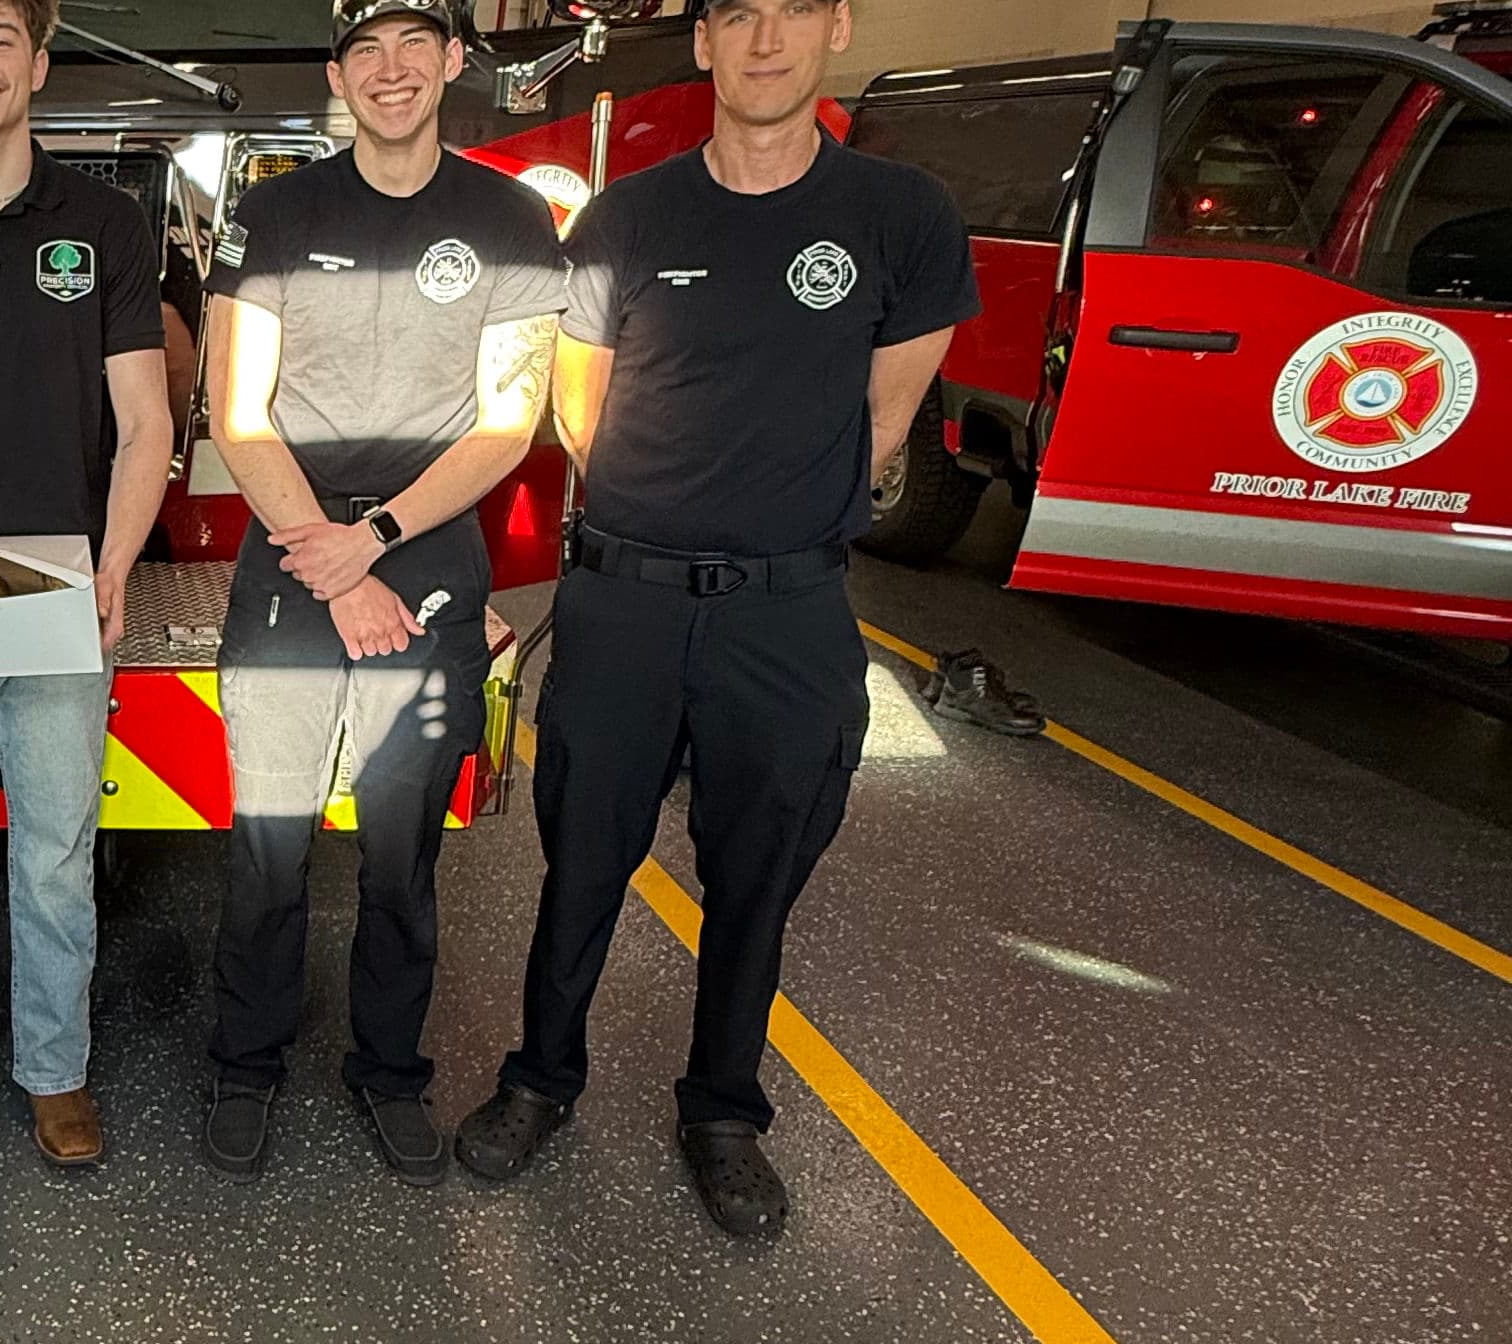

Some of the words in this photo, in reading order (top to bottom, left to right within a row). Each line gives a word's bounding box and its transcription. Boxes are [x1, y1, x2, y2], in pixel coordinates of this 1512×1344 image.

[40, 276, 90, 285] PRECISION
[1342, 315, 1445, 338] INTEGRITY
[1277, 358, 1307, 417] HONOR
[1434, 359, 1473, 437] EXCELLENCE
[1296, 440, 1413, 470] COMMUNITY
[1210, 471, 1307, 499] PRIOR
[1308, 480, 1393, 507] LAKE
[1393, 487, 1470, 514] FIRE
